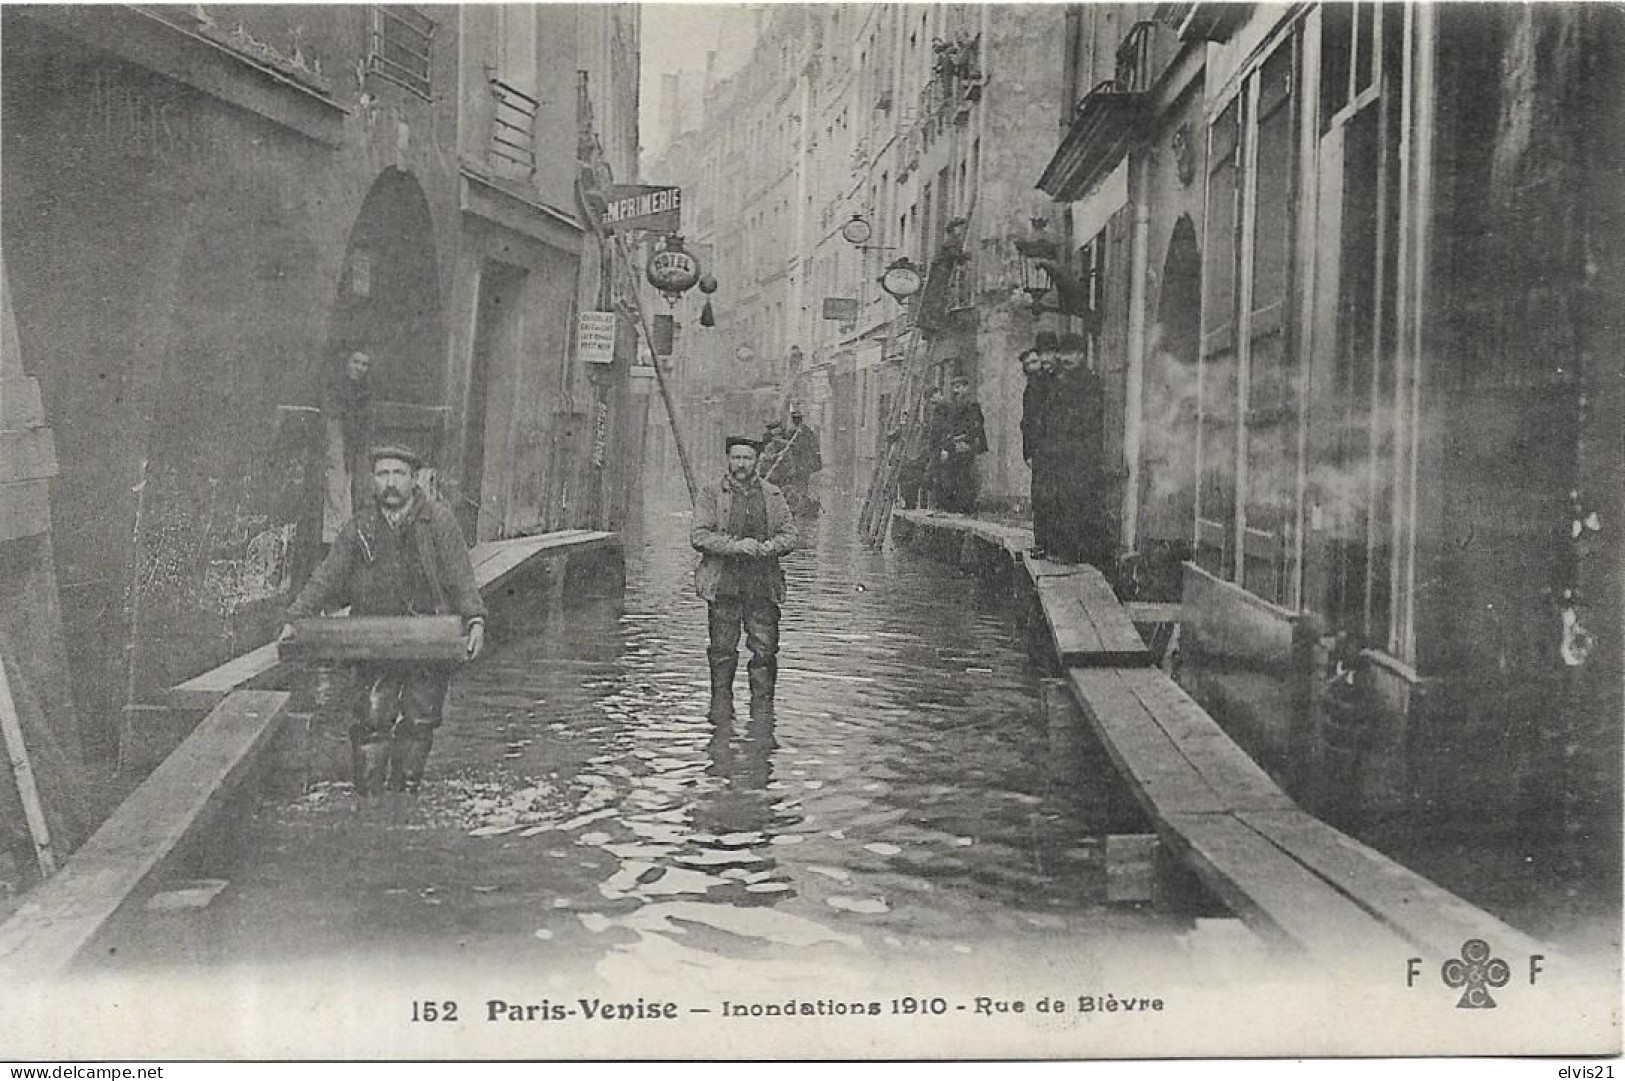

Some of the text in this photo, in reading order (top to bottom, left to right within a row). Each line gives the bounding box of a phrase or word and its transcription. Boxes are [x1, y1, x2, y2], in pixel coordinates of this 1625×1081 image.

[1406, 956, 1423, 988] F
[1529, 953, 1546, 986] F
[411, 993, 1164, 1022] 152 Paris-Venise Inondations 1910 Rue de Bièvre
